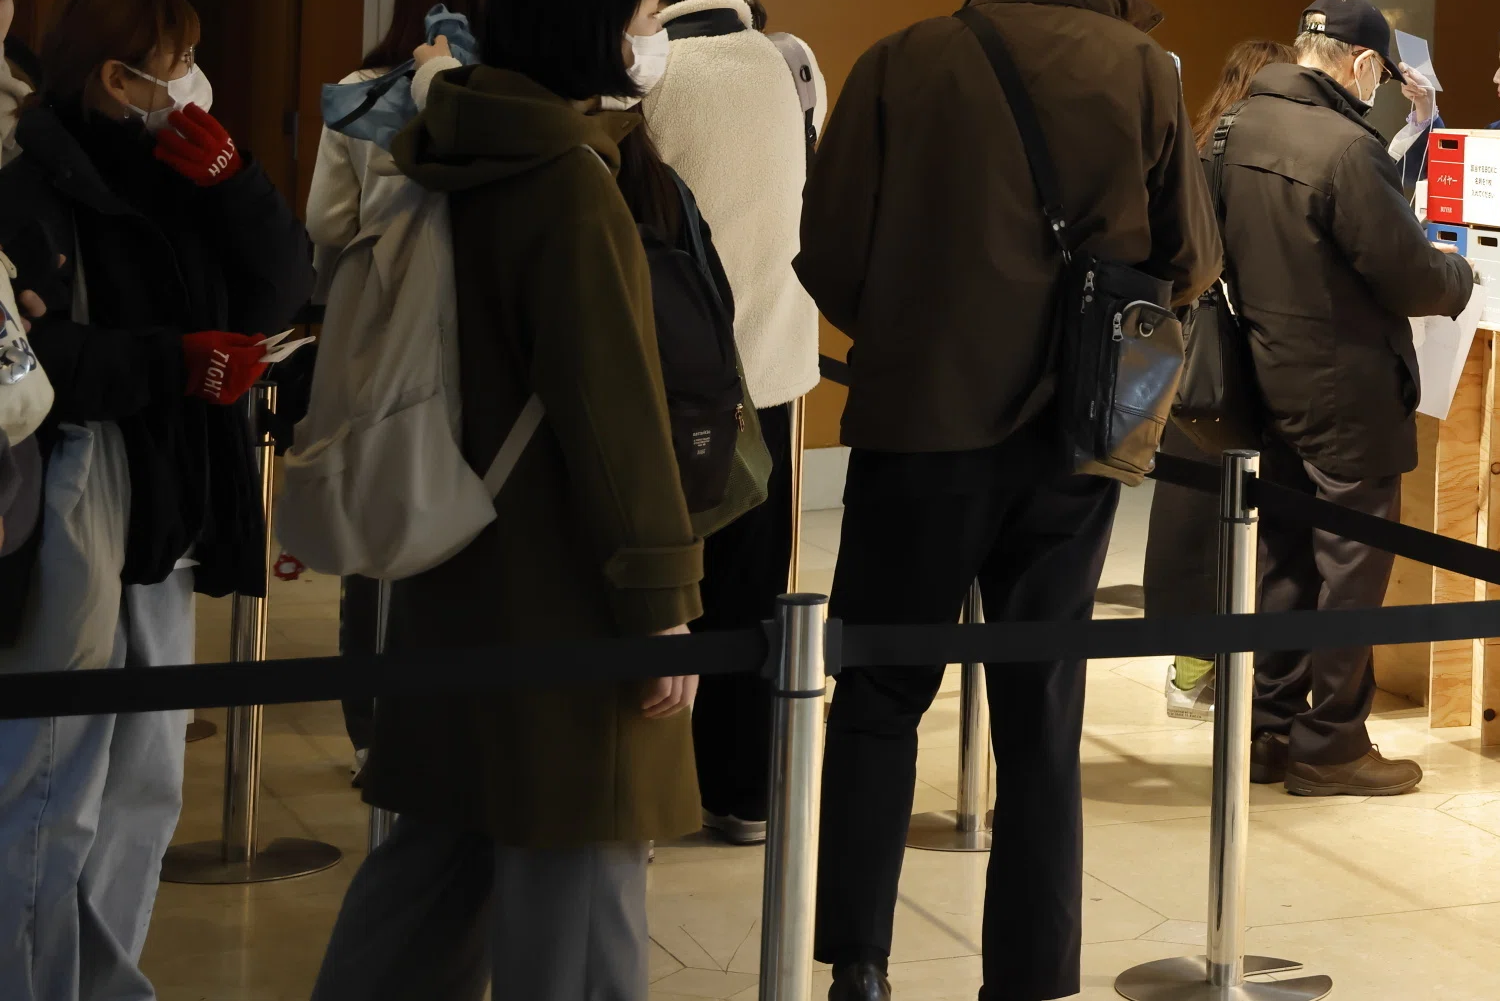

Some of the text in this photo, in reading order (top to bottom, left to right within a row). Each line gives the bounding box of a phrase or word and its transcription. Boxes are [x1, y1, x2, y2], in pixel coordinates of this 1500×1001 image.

[1436, 174, 1458, 186] バイヤー
[203, 349, 230, 398] TIGHT
